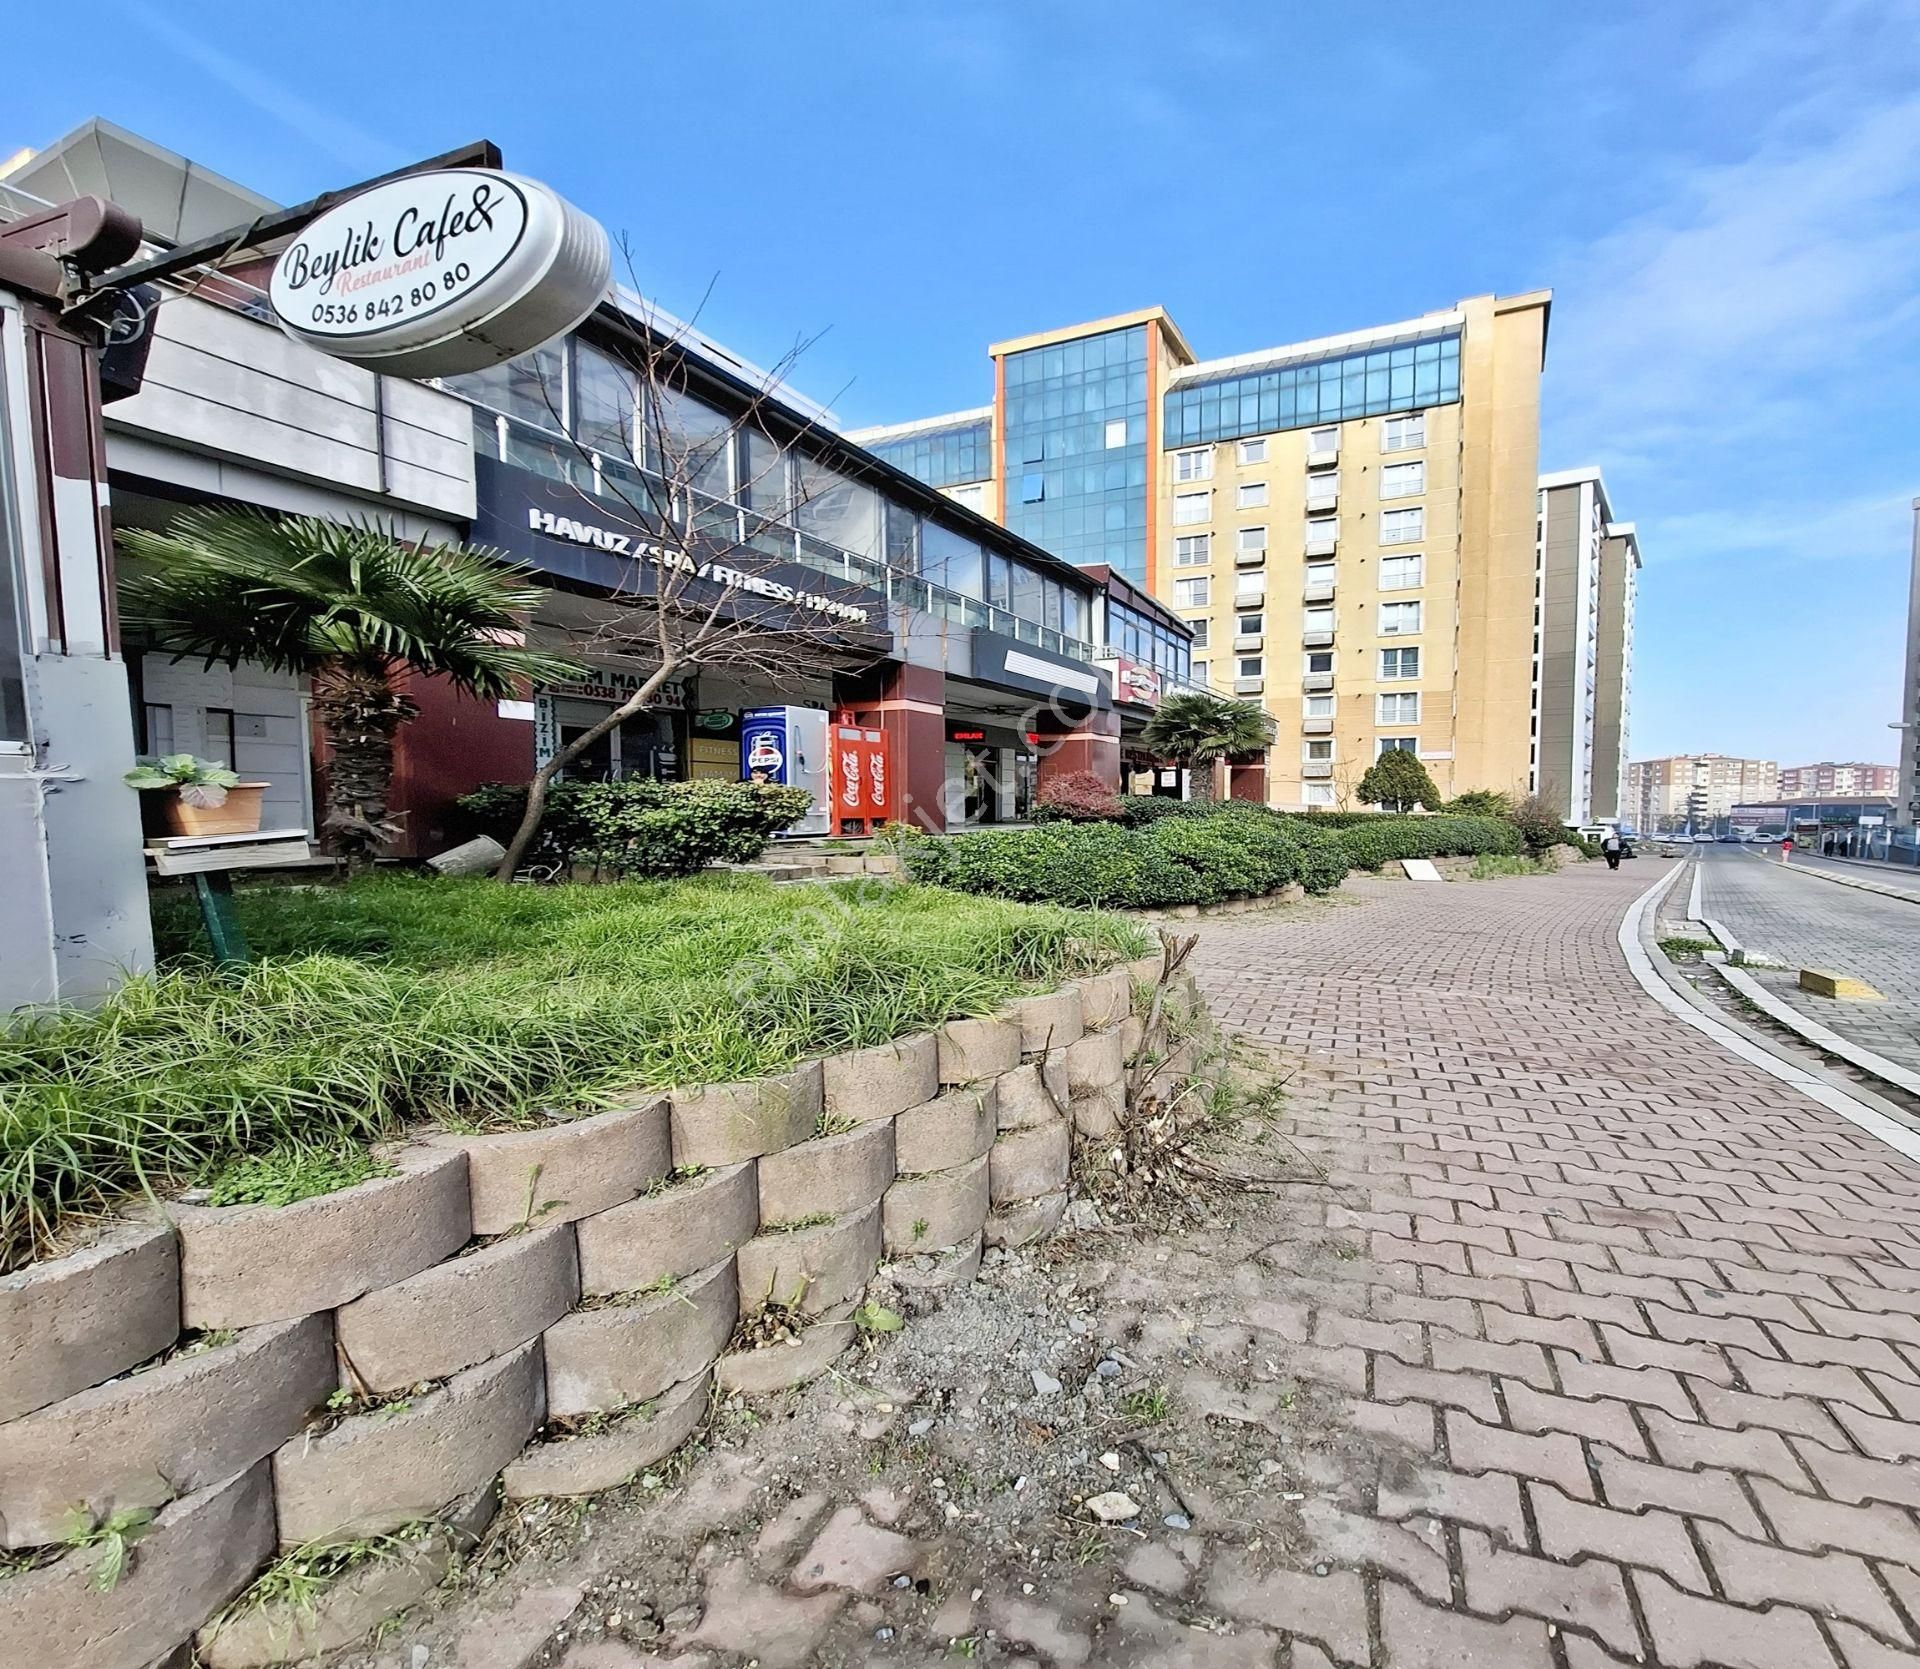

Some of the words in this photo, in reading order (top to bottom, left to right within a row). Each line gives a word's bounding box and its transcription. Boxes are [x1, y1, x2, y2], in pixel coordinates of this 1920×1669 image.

[283, 221, 386, 296] Beylik
[393, 184, 505, 262] Cafe&
[312, 303, 358, 325] 0536
[365, 294, 404, 322] 842
[411, 281, 436, 307] 80
[443, 262, 471, 291] 80
[336, 249, 432, 297] Restaurant
[528, 508, 632, 556] HAVUZ
[610, 672, 682, 695] MARET
